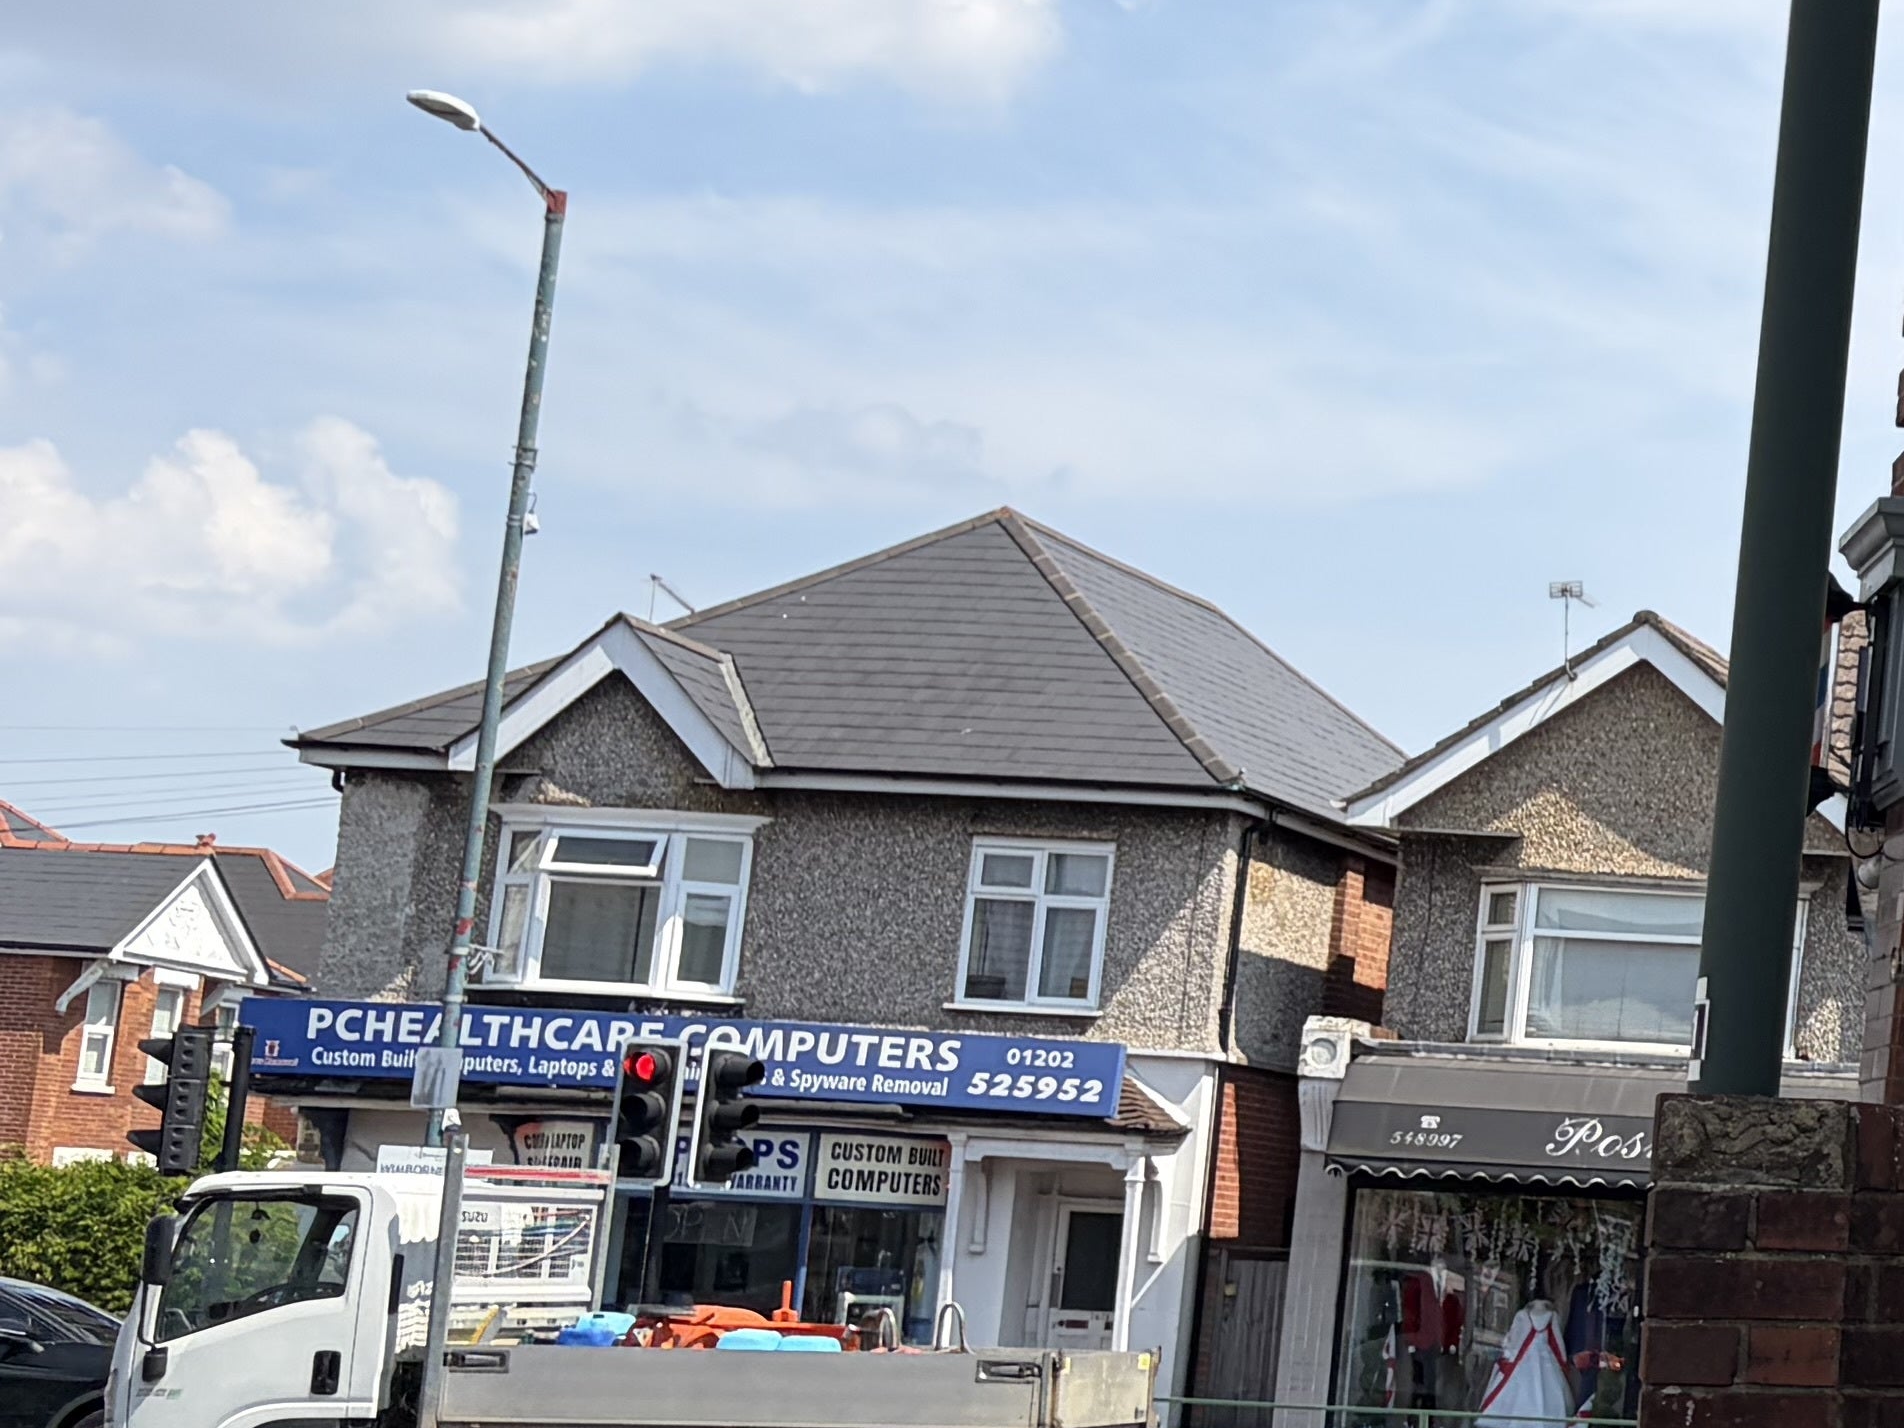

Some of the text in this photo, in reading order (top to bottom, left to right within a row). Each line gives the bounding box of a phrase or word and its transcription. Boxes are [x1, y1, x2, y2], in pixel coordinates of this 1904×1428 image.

[307, 1007, 664, 1053] PCHEALTHCARE
[679, 1023, 961, 1072] COMPUTERS
[311, 1047, 375, 1067] Custom
[382, 1049, 418, 1070] Buil
[528, 1055, 598, 1080] Laptops
[601, 1059, 615, 1077] &
[771, 1068, 785, 1087] &
[790, 1069, 867, 1093] Spyware
[872, 1074, 948, 1097] Removal
[1007, 1048, 1074, 1068] 01202
[967, 1072, 1103, 1103] 525952
[1390, 1131, 1464, 1149] 548997
[1545, 1117, 1653, 1158] Pos
[831, 1141, 944, 1168] CUSTOM BUILT
[828, 1167, 941, 1196] COMPUTERS
